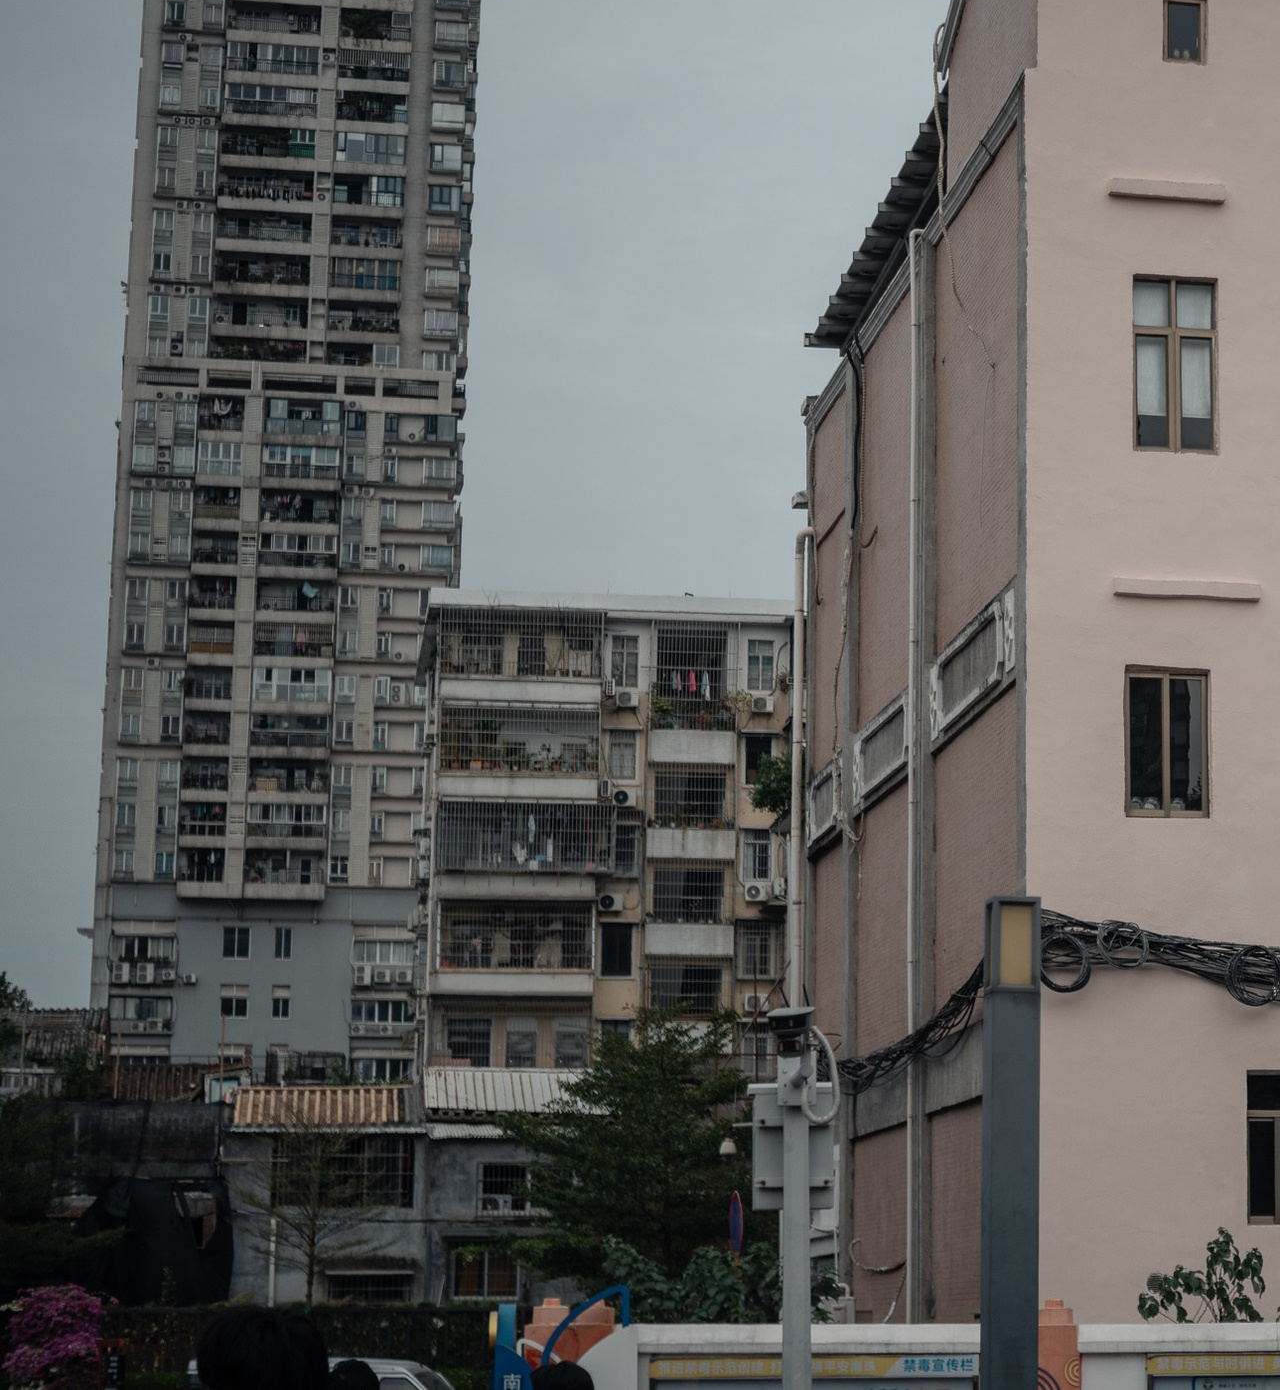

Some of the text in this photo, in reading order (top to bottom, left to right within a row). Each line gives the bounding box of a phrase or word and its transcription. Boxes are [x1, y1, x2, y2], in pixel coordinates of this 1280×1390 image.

[903, 1358, 974, 1373] 禁毒宣传栏
[1157, 1356, 1266, 1371] 禁毒示范与时俱进
